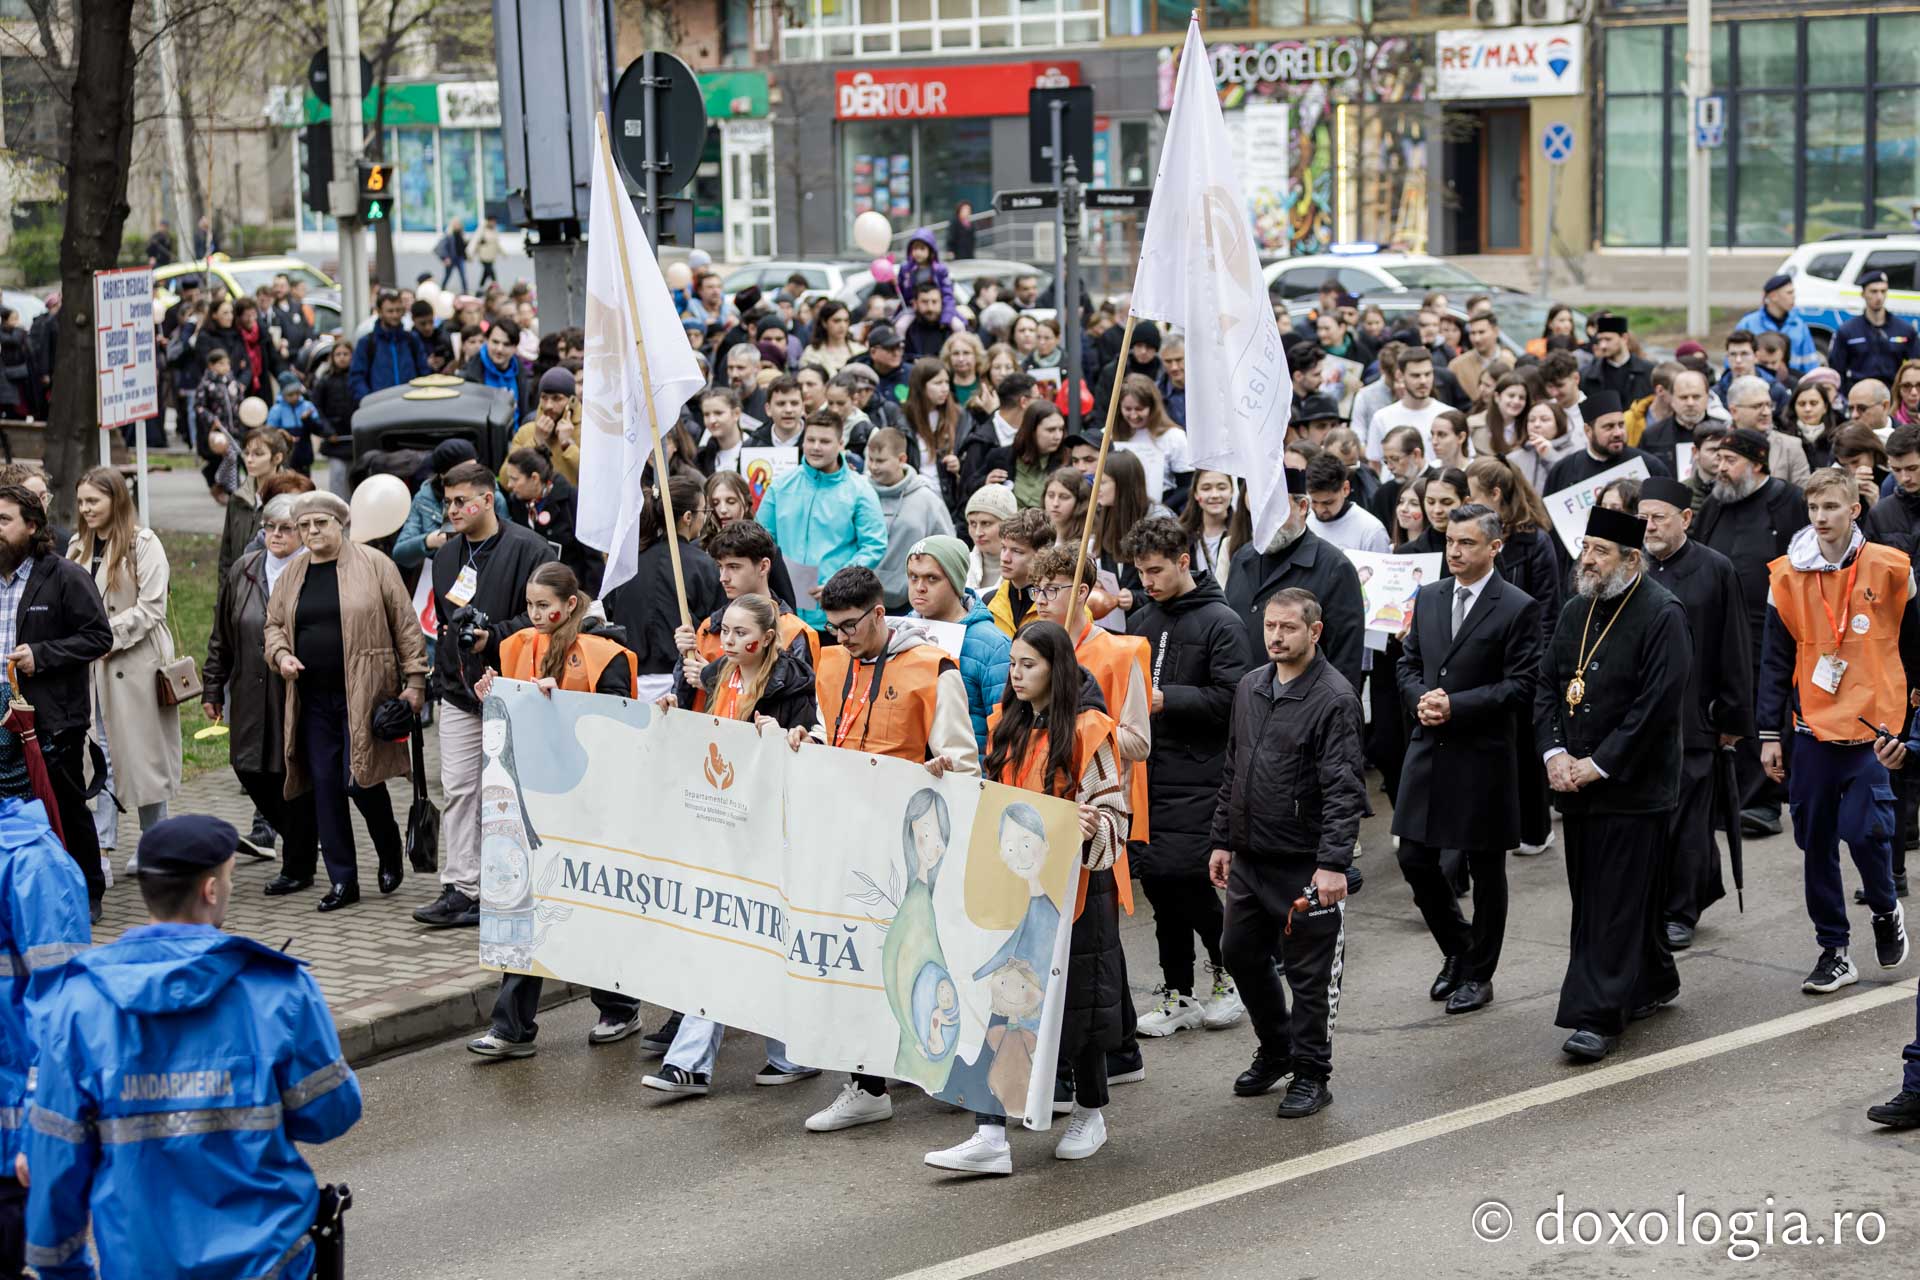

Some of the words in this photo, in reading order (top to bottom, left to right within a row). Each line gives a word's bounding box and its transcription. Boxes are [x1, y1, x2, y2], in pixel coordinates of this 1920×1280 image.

[1210, 42, 1358, 84] DECORELLO
[1441, 42, 1538, 69] RE/MAX
[840, 78, 948, 117] DERTOUR
[1159, 631, 1168, 648] GOOD
[1155, 648, 1165, 668] THINGS
[1152, 676, 1160, 690] COM
[1153, 668, 1160, 676] TO
[788, 923, 864, 977] AŢĂ
[119, 1070, 234, 1102] JANDARMERIA
